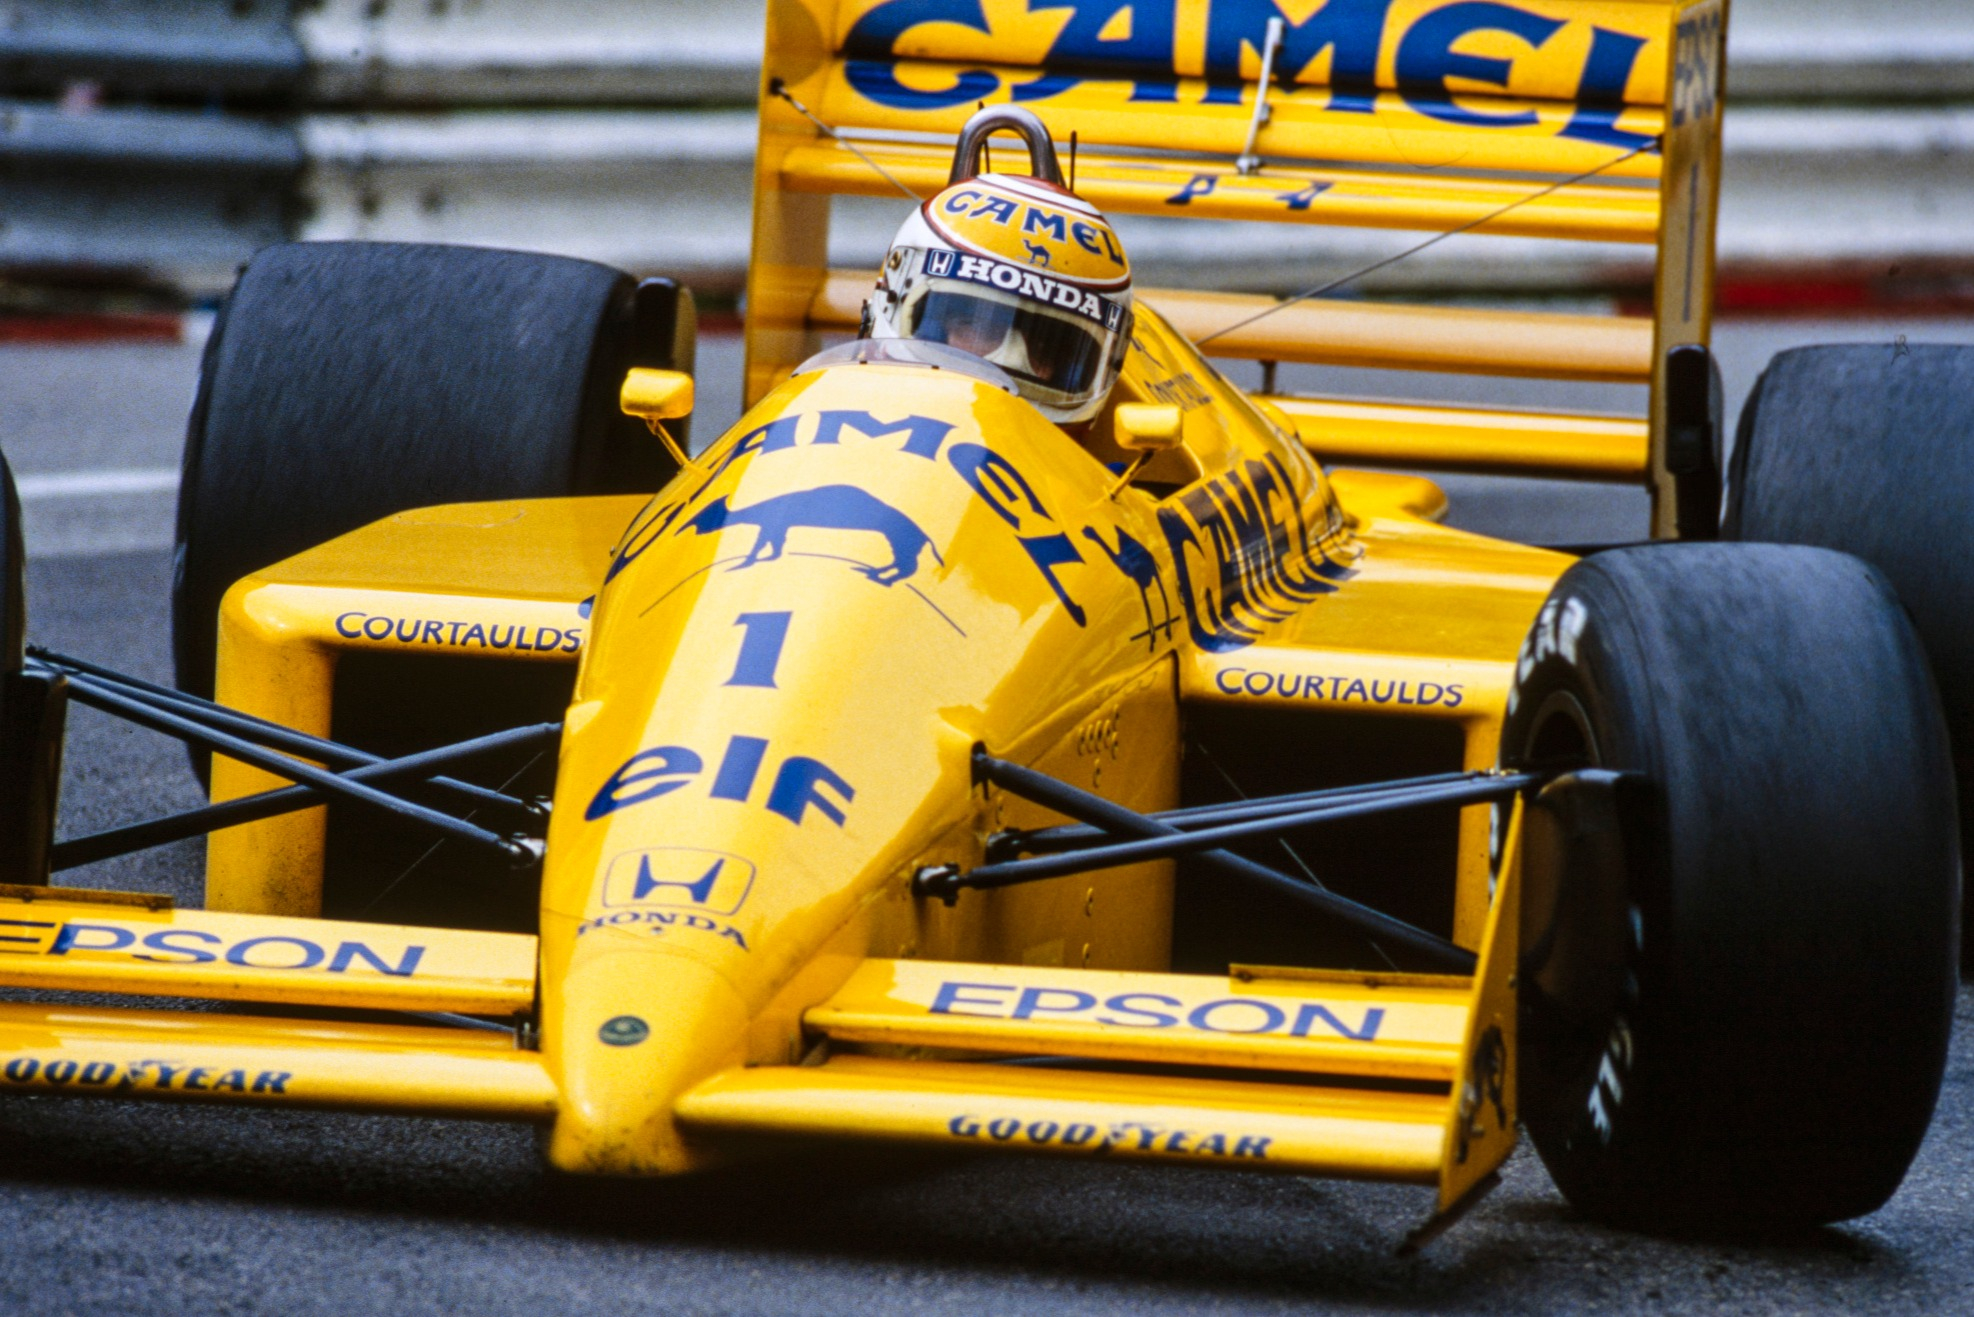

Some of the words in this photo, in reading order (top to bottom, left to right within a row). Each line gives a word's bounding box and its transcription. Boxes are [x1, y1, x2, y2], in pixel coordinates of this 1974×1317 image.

[843, 0, 1662, 155] CAMEL
[945, 190, 1124, 267] CAMEL
[957, 255, 1102, 321] HONDA
[335, 612, 582, 653] COURTAULDS
[722, 611, 793, 689] 1
[1216, 667, 1464, 707] COURTAULDS
[577, 911, 749, 952] HONDA
[928, 981, 1386, 1041] EPSON
[5, 1056, 292, 1093] OODYEAR
[948, 1114, 1273, 1159] GOODYEAR
